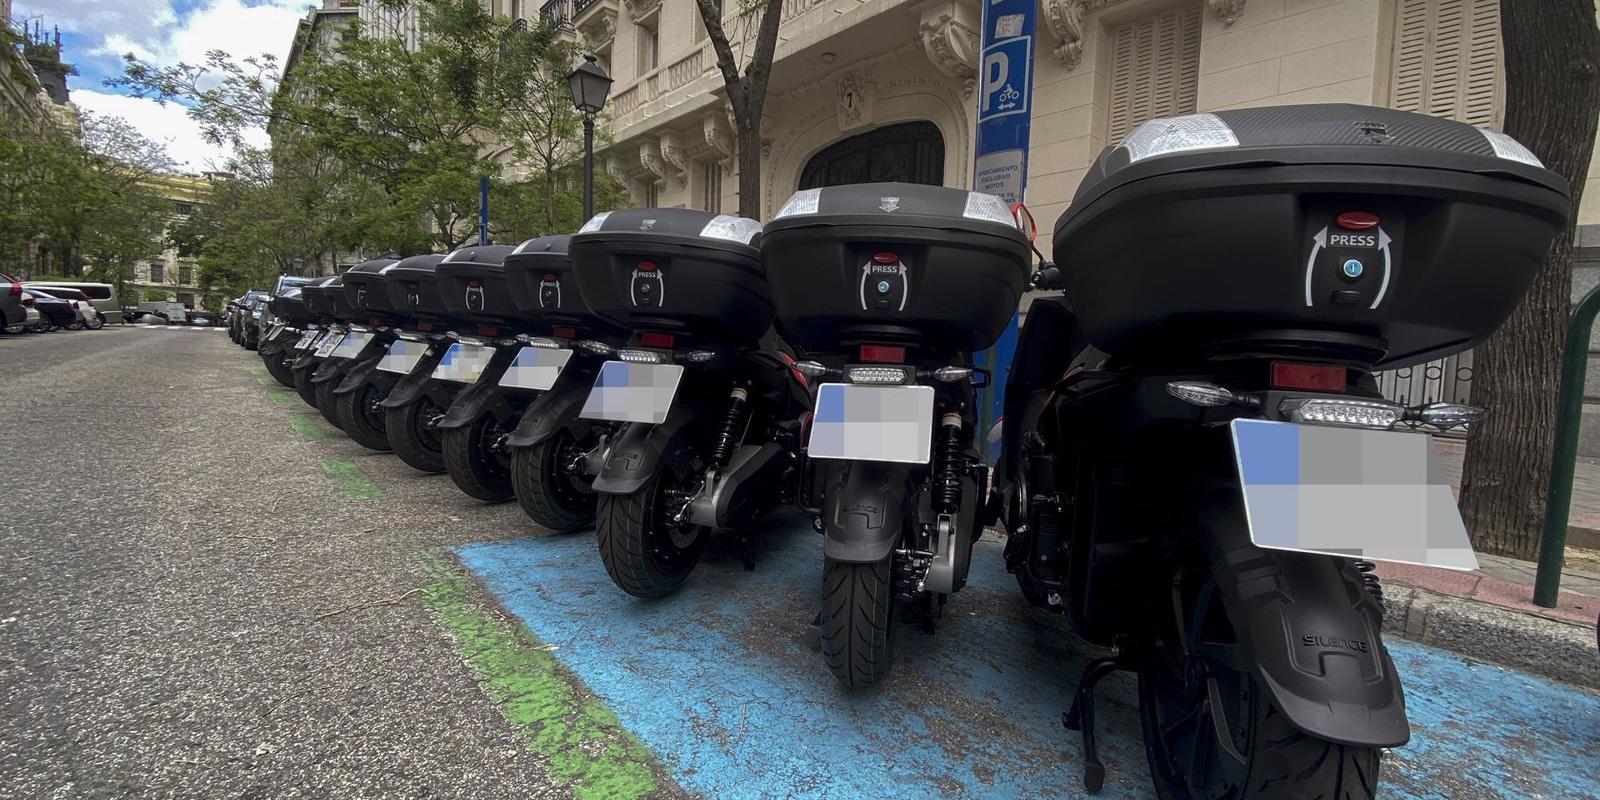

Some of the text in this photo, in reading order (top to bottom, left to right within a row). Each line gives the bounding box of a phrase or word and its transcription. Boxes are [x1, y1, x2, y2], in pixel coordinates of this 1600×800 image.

[982, 51, 1009, 112] P
[1330, 234, 1375, 247] PRESS
[872, 265, 898, 273] PRESS
